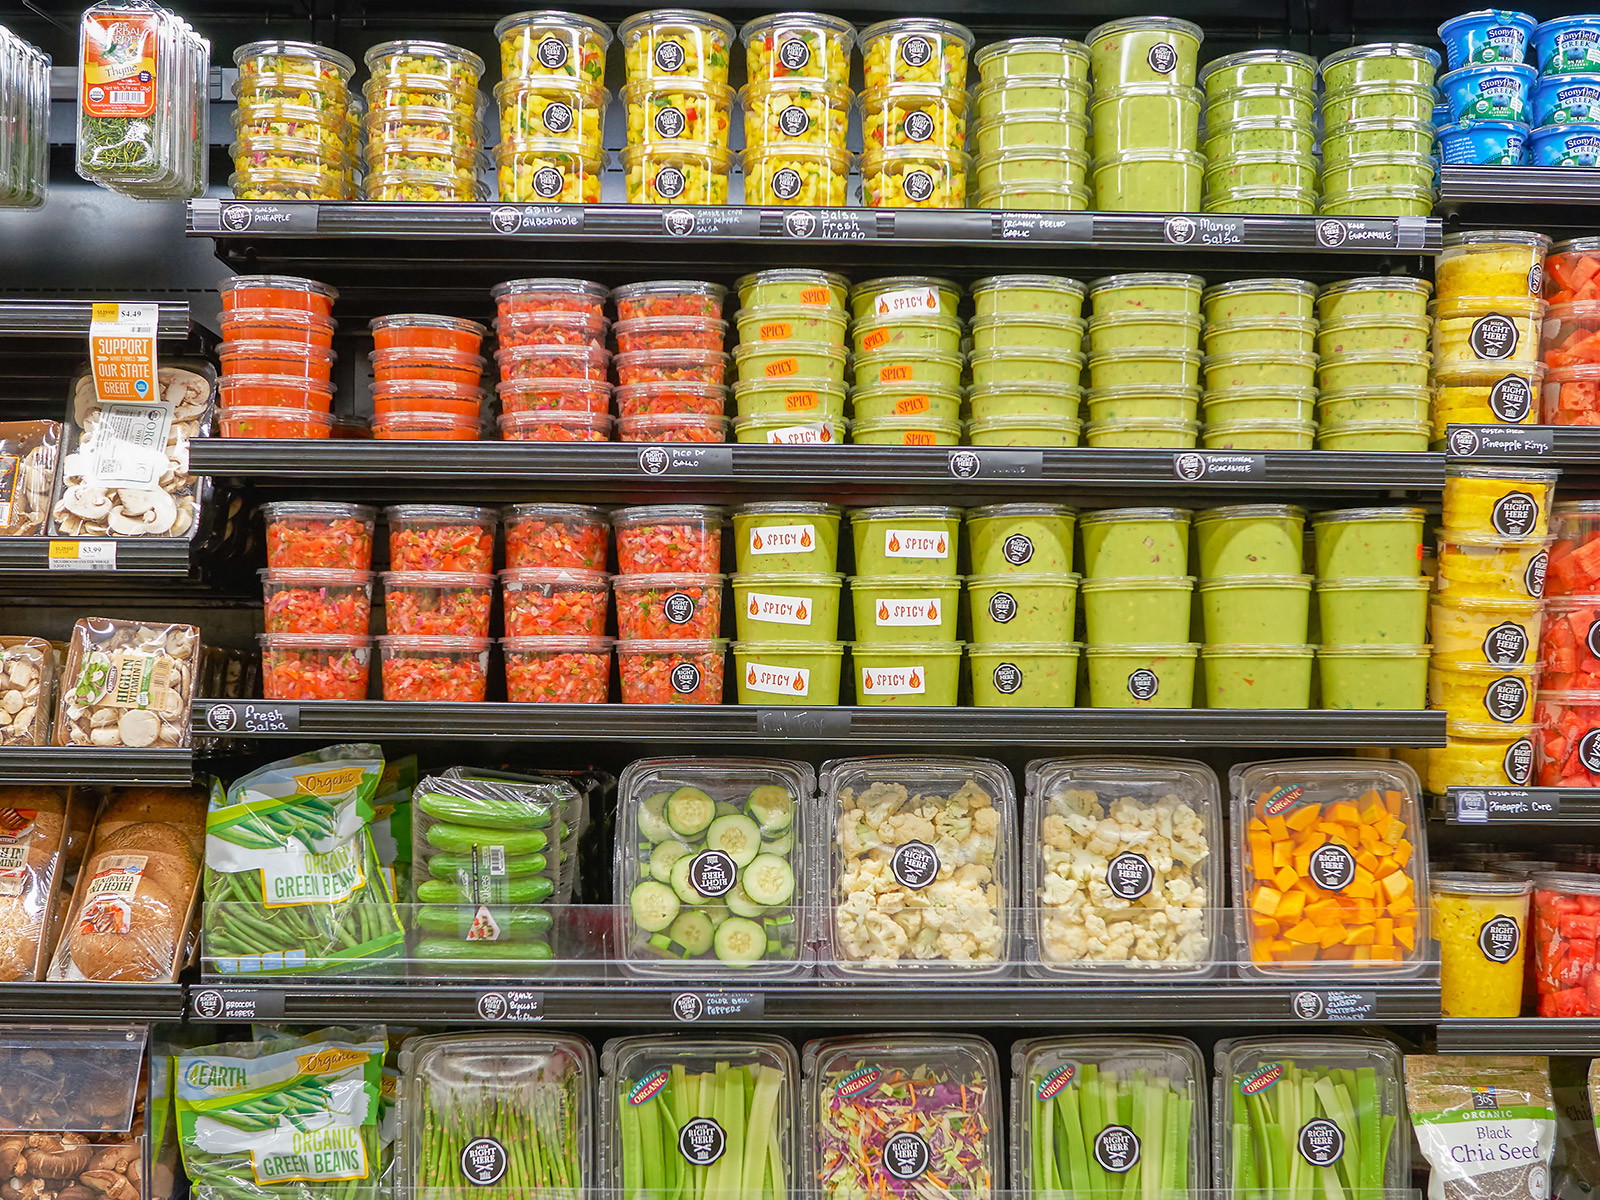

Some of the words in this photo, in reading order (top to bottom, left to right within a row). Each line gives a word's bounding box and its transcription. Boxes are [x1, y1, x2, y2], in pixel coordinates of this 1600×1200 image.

[1556, 30, 1598, 45] Stonyfield
[1562, 40, 1591, 48] GREEK
[105, 65, 137, 78] Thyme
[1480, 77, 1520, 91] Stonyfield
[1558, 87, 1600, 101] Stonyfield
[525, 206, 562, 214] Garlic
[820, 210, 858, 220] Salsa
[254, 213, 291, 223] PINEAPPLE
[522, 215, 578, 227] Guacamole
[1003, 220, 1036, 228] ORGANIC
[822, 220, 860, 231] Fresh
[1200, 218, 1236, 234] Mango
[822, 230, 865, 239] Mango
[1002, 229, 1030, 238] GARLIC
[1202, 232, 1240, 245] Salsa
[1348, 231, 1392, 240] GUACAMOLE
[803, 290, 826, 303] SPICY
[894, 297, 923, 309] SPICY
[761, 325, 785, 337] SPICY
[1481, 324, 1510, 334] RIGHT
[864, 331, 884, 349] SPICY
[1482, 332, 1508, 341] HERE
[98, 339, 149, 354] SUPPORT
[98, 363, 118, 377] OUR
[120, 363, 150, 378] STATE
[767, 361, 792, 376] SPICY
[882, 367, 907, 380] SPICY
[104, 381, 130, 394] GREAT
[1501, 386, 1526, 396] RIGHT
[787, 395, 813, 408] SPICY
[1502, 393, 1524, 403] HERE
[898, 398, 925, 413] SPICY
[788, 431, 817, 443] SPICY
[906, 432, 931, 445] SPICY
[1482, 437, 1521, 452] Pineapple
[1524, 440, 1549, 454] Rings
[672, 449, 692, 457] PICO
[1503, 503, 1531, 511] RIGHT
[1505, 510, 1529, 519] HERE
[767, 534, 796, 545] SPICY
[905, 537, 934, 549] SPICY
[763, 602, 793, 616] SPICY
[894, 605, 924, 617] SPICY
[1495, 633, 1522, 643] RIGHT
[1496, 640, 1520, 650] HERE
[122, 659, 134, 671] IN
[128, 667, 141, 703] VITAMIN
[760, 673, 790, 686] SPICY
[876, 674, 905, 686] SPICY
[116, 674, 131, 702] HIGH
[1497, 686, 1522, 695] RIGHT
[1498, 693, 1520, 702] HERE
[245, 705, 283, 721] Fresh
[245, 720, 288, 732] Salsa
[1514, 749, 1532, 757] RIGHT
[1514, 756, 1530, 764] HERE
[305, 773, 354, 791] Organic
[1269, 788, 1302, 814] ORGANIC
[1489, 801, 1528, 813] Pineapple
[904, 850, 931, 862] RIGHT
[904, 858, 928, 869] HERE
[1117, 862, 1144, 871] RIGHT
[1320, 861, 1344, 870] HERE
[101, 876, 134, 884] VITAMIN
[701, 871, 725, 879] HERE
[1118, 870, 1142, 879] HERE
[103, 882, 133, 892] HIGH
[274, 875, 319, 899] GREEN
[700, 879, 728, 887] RIGHT
[1490, 926, 1515, 934] RIGHT
[1491, 933, 1513, 941] HERE
[707, 1005, 741, 1015] PEPPERS
[307, 1052, 359, 1070] Organic
[838, 1067, 873, 1089] CERTIFIED
[841, 1072, 877, 1095] ORGANIC
[1042, 1068, 1074, 1099] ORGANIC
[1246, 1068, 1280, 1093] ORGANIC
[629, 1071, 661, 1098] CERTIFIED
[633, 1074, 667, 1104] ORGANIC
[1477, 1094, 1494, 1106] 365
[1462, 1110, 1512, 1119] ORGANIC
[688, 1128, 716, 1137] RIGHT
[1307, 1129, 1334, 1138] RIGHT
[1476, 1125, 1512, 1139] Black
[292, 1127, 358, 1154] ORGANIC
[690, 1135, 714, 1144] HERE
[1103, 1135, 1130, 1144] RIGHT
[1309, 1136, 1333, 1145] HERE
[469, 1147, 497, 1158] RIGHT
[892, 1142, 920, 1151] RIGHT
[1105, 1142, 1129, 1151] HERE
[1451, 1143, 1496, 1162] Chia
[1499, 1140, 1540, 1161] Seed
[472, 1154, 496, 1165] HERE
[894, 1149, 918, 1158] HERE
[263, 1155, 310, 1176] GREEN
[314, 1150, 360, 1173] BEANS
